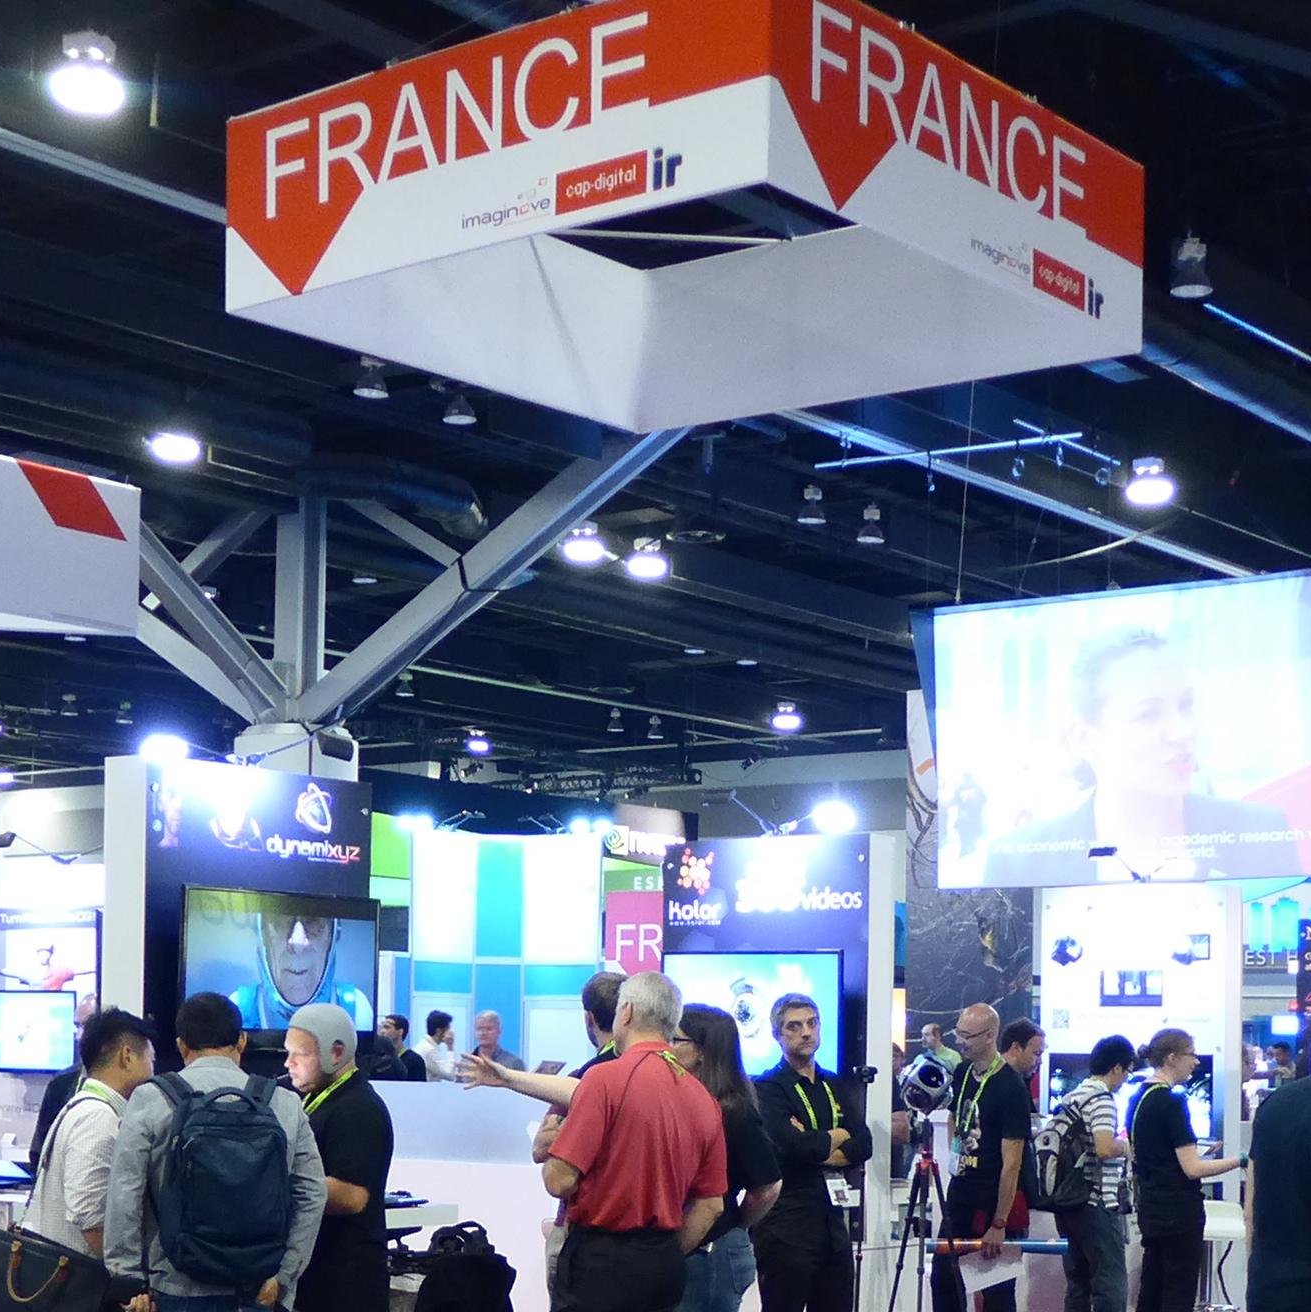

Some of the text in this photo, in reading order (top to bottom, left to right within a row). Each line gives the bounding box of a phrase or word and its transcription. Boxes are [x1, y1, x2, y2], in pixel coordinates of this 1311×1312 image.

[266, 11, 649, 220] FRANCE
[811, 0, 1088, 236] FRANCE
[461, 196, 551, 230] imaginove
[266, 833, 361, 864] dynamixyz
